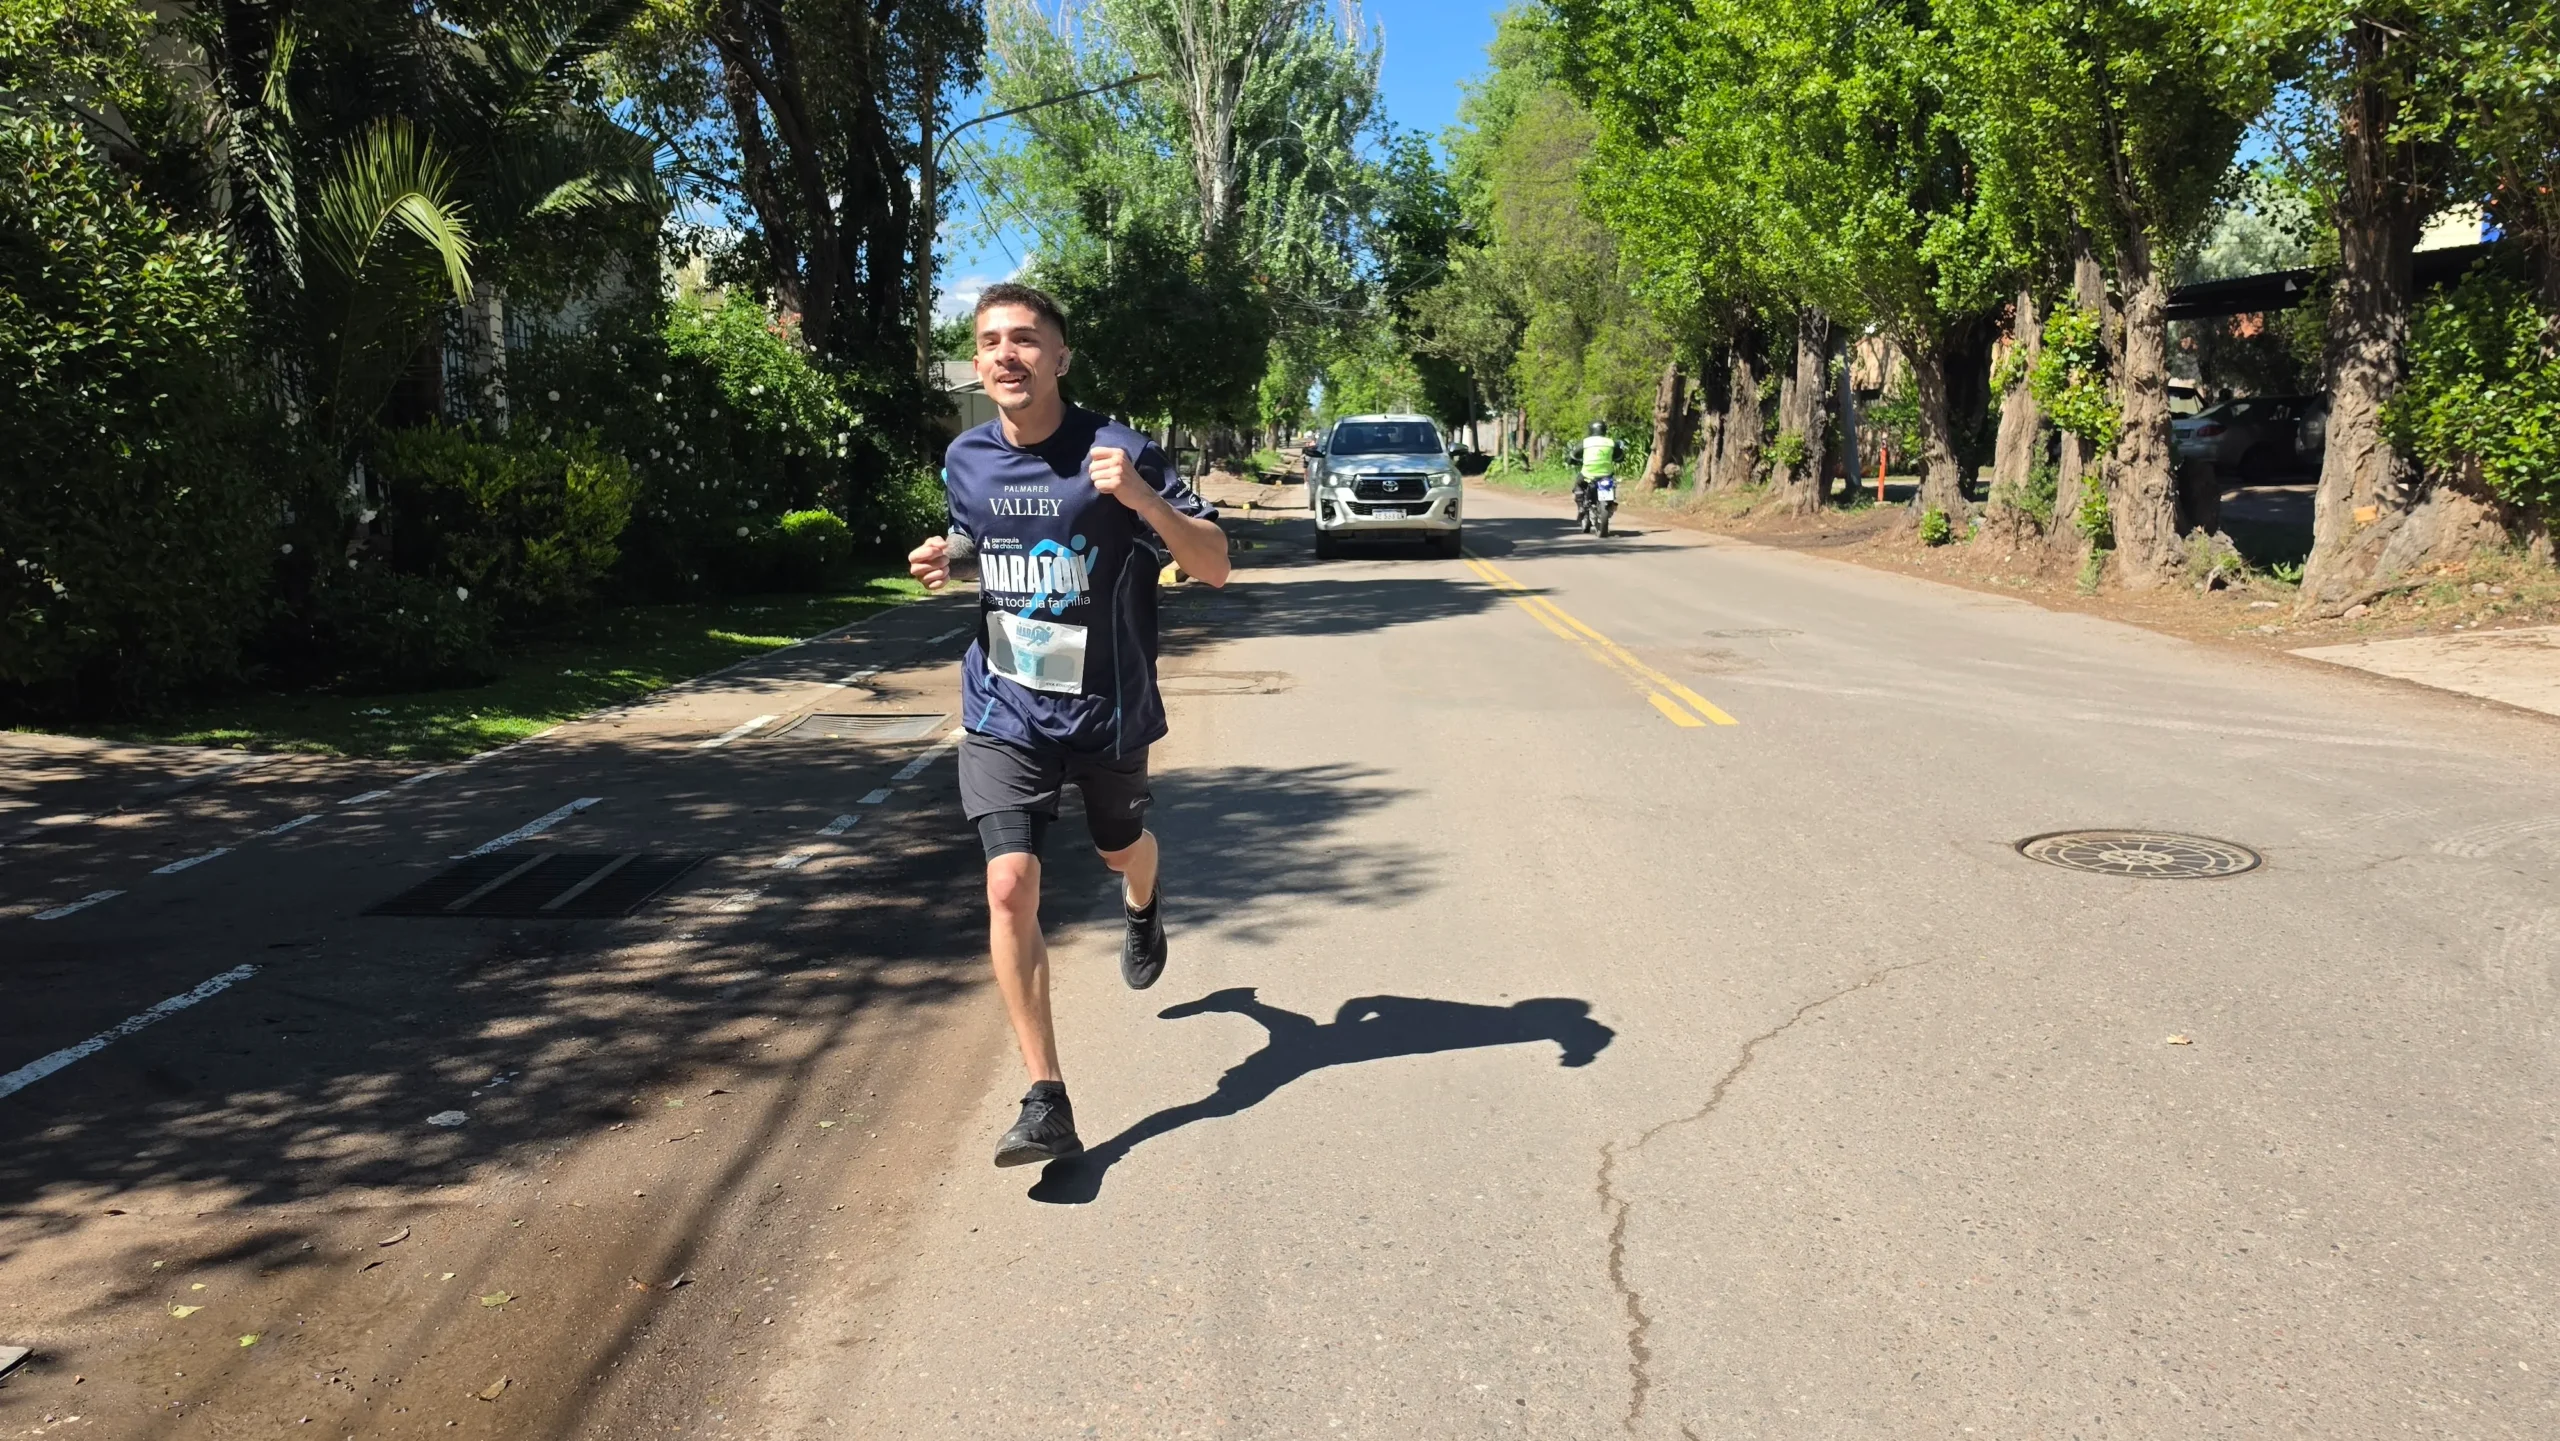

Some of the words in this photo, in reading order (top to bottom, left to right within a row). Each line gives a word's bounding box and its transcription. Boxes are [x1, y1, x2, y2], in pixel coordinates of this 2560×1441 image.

[1004, 485, 1049, 493] PALMARES
[988, 498, 1063, 516] VALLEY
[992, 536, 1020, 544] parroquia
[980, 548, 1090, 594] MARATÓN
[1006, 596, 1033, 608] toda
[1035, 597, 1046, 608] la
[1048, 596, 1091, 609] familia
